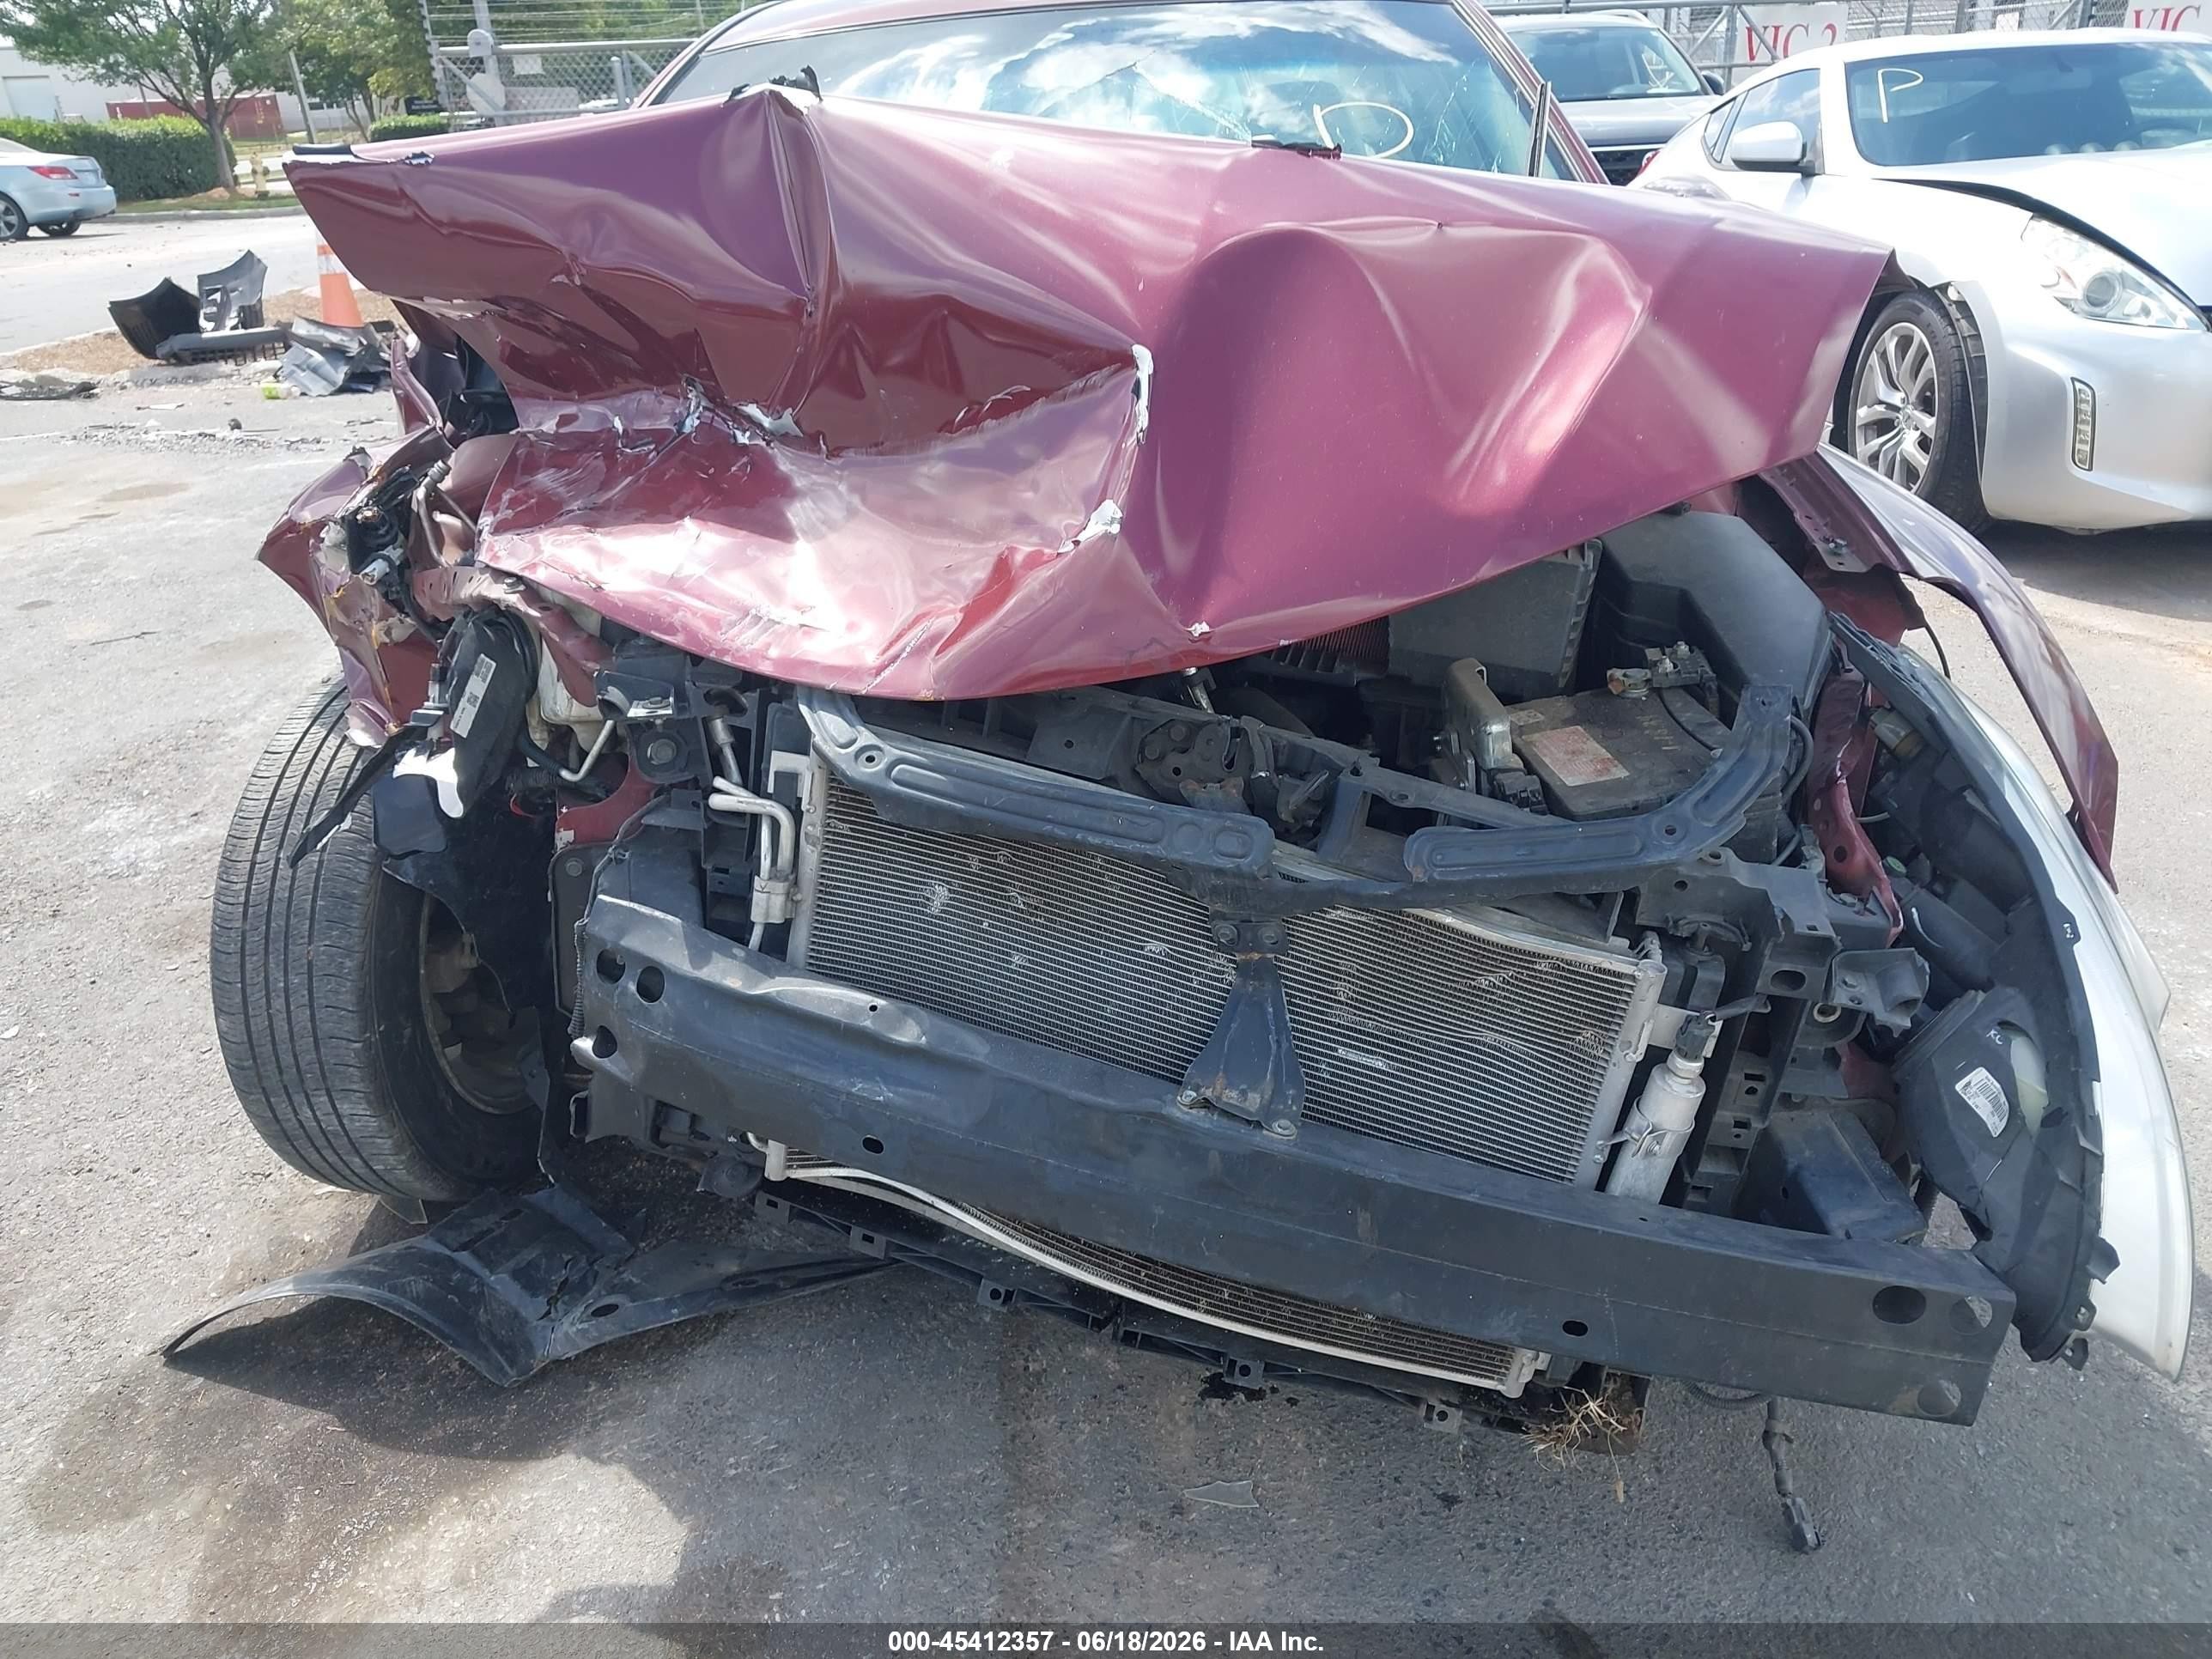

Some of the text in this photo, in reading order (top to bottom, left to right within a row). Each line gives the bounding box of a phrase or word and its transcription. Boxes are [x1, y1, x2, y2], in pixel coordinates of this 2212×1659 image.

[2133, 5, 2202, 32] VIC
[1745, 22, 1810, 62] VIC
[1877, 68, 1924, 124] P
